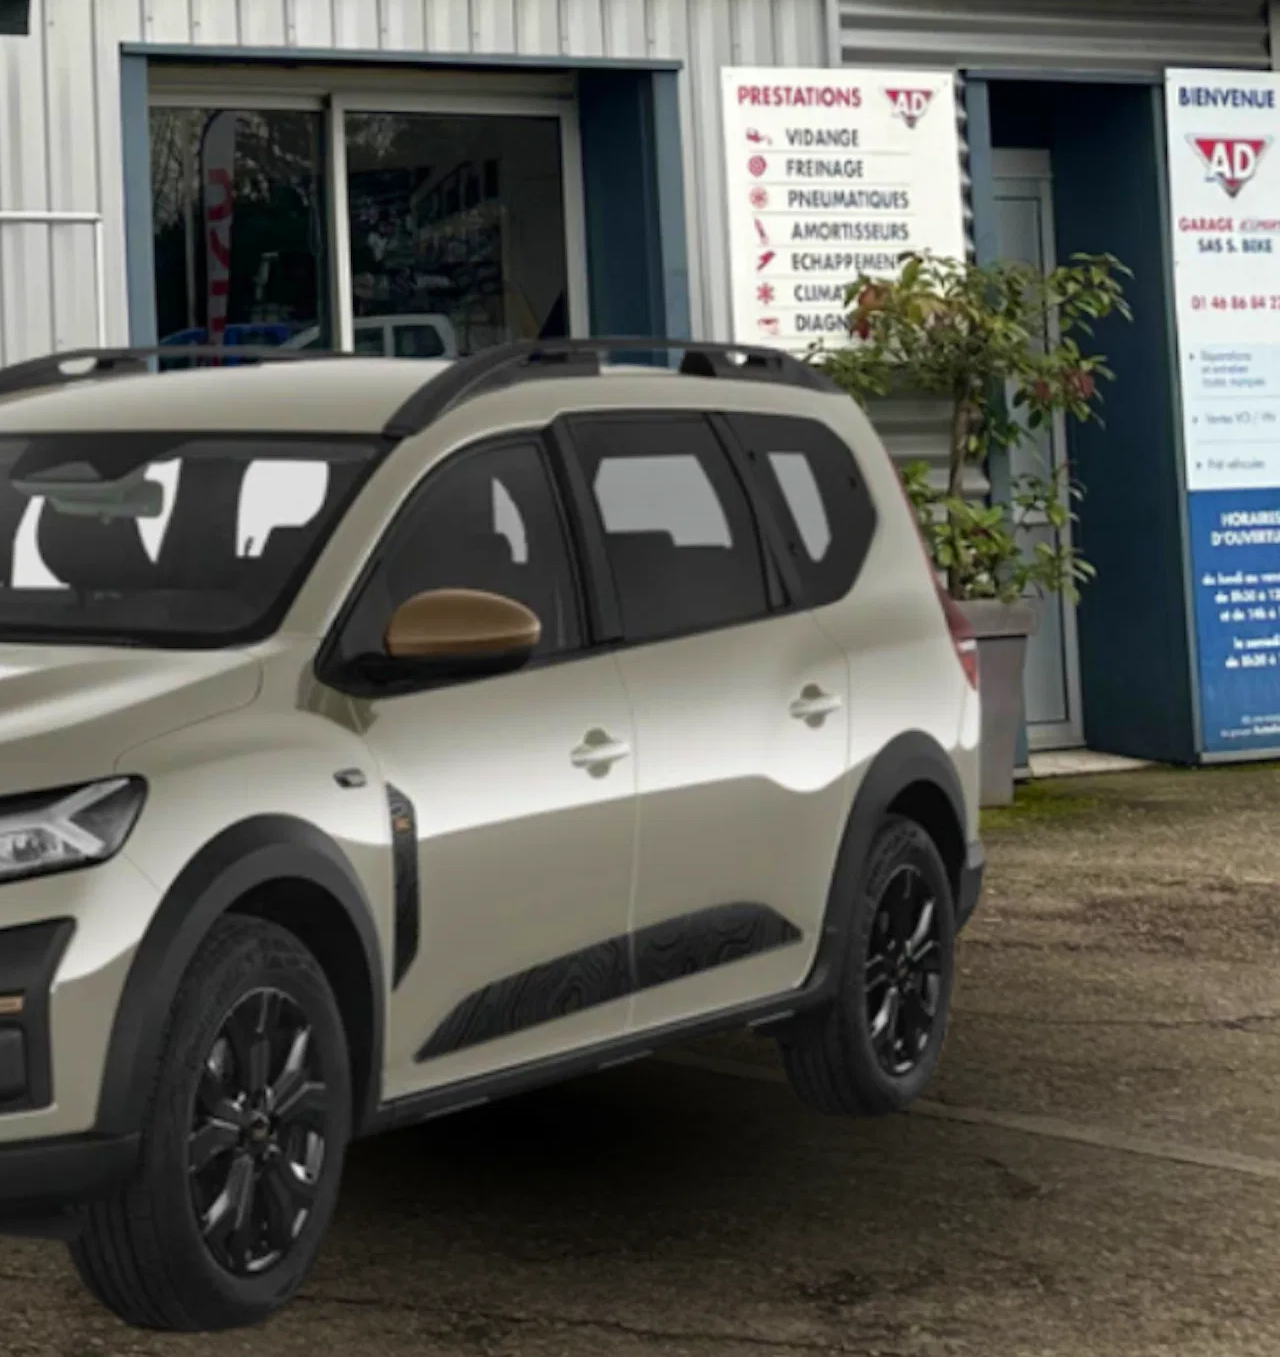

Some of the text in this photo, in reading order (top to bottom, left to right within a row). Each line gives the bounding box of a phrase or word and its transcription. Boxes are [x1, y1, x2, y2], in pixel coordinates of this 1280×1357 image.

[737, 86, 862, 108] PRESTATIONS
[1178, 87, 1276, 108] BIENVENUE
[785, 128, 860, 147] VIDANGE
[786, 159, 864, 178] FREINAGE
[1211, 141, 1256, 181] AD
[787, 190, 910, 210] PNEUMATIQUES
[791, 222, 910, 241] AMORTISSEURS
